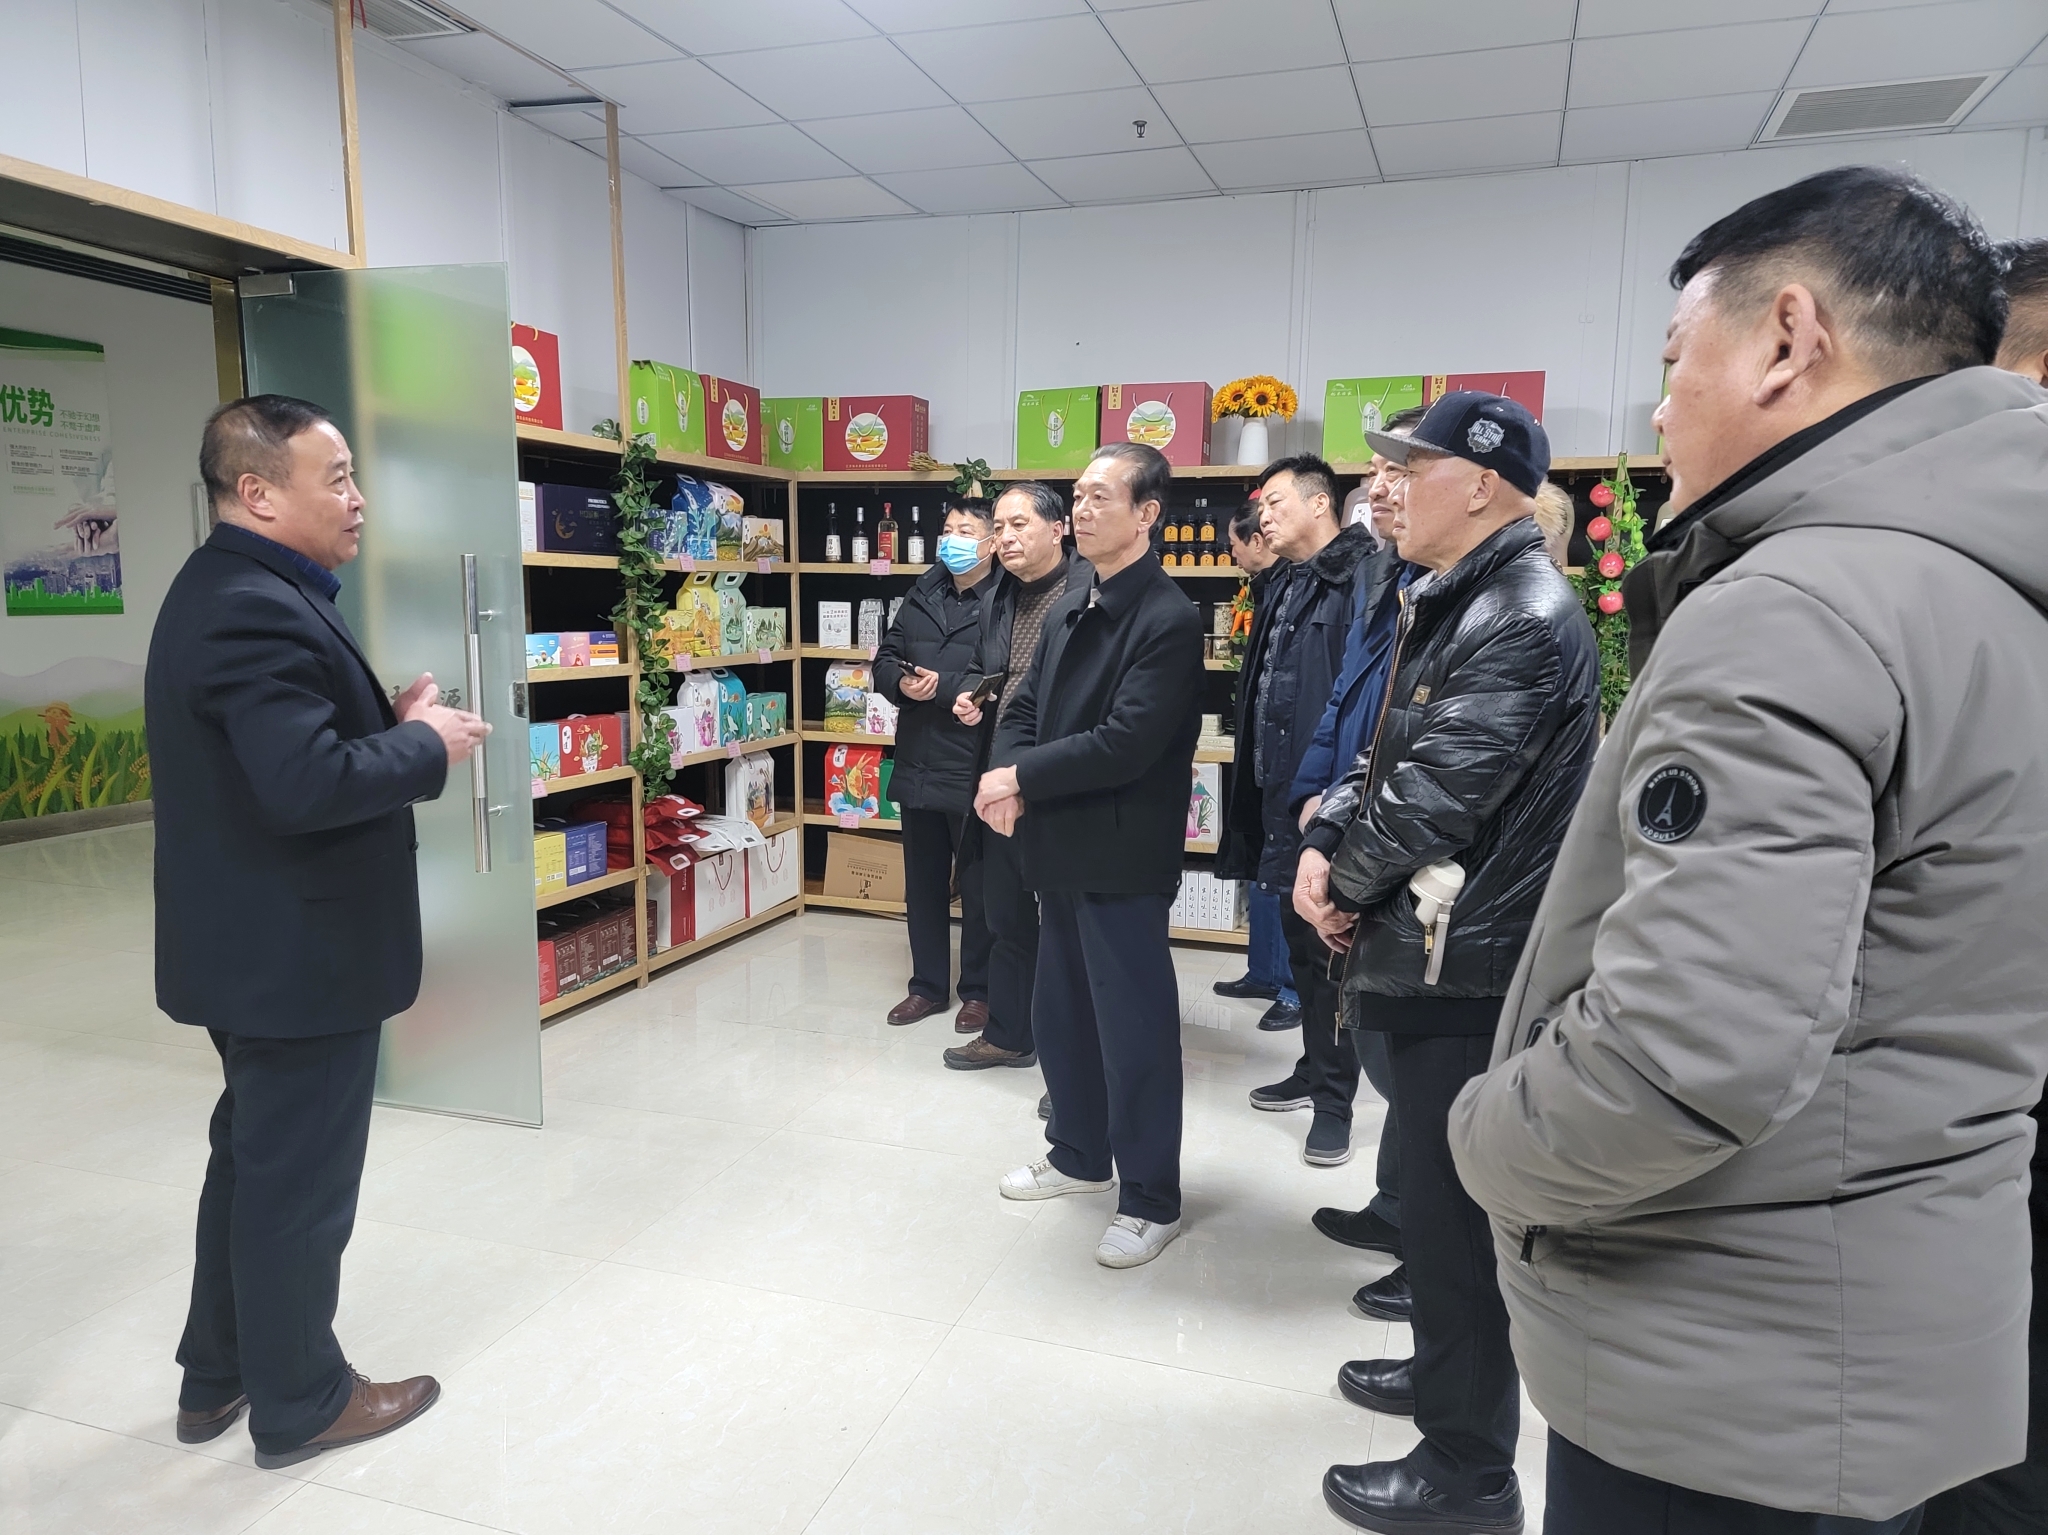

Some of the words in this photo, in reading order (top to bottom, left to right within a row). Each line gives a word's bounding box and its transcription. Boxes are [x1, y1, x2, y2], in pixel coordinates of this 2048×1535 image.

[0, 384, 55, 427] 优势
[60, 409, 100, 422] 不驰于幻想
[3, 426, 47, 437] ENTERPRISE
[49, 431, 101, 442] COHESIVENESS
[1471, 422, 1484, 435] ALL
[1483, 428, 1502, 445] STAR
[1473, 434, 1491, 446] GAME
[1680, 770, 1702, 796] STRONG
